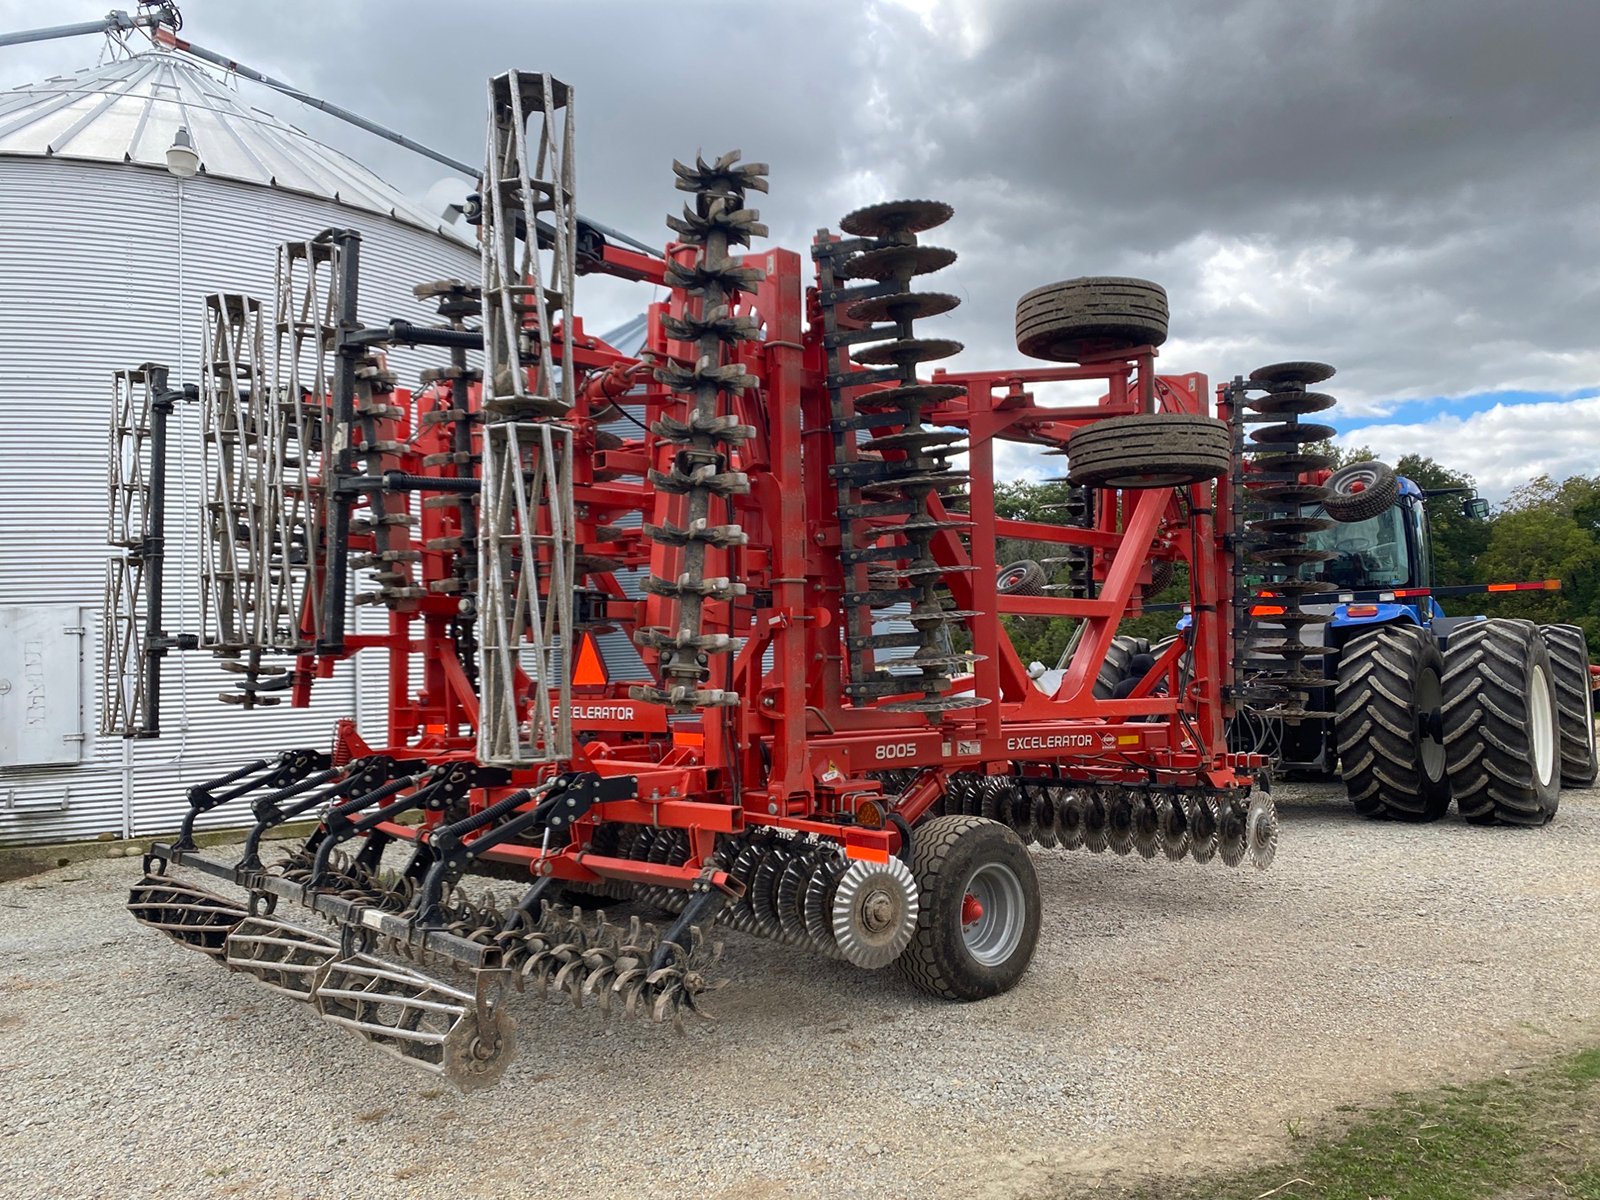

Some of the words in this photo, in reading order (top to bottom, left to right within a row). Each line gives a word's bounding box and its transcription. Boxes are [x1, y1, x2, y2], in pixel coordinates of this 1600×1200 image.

[552, 706, 634, 720] EELERATOR
[1007, 734, 1093, 750] EXCELERATOR
[875, 743, 916, 759] 8005
